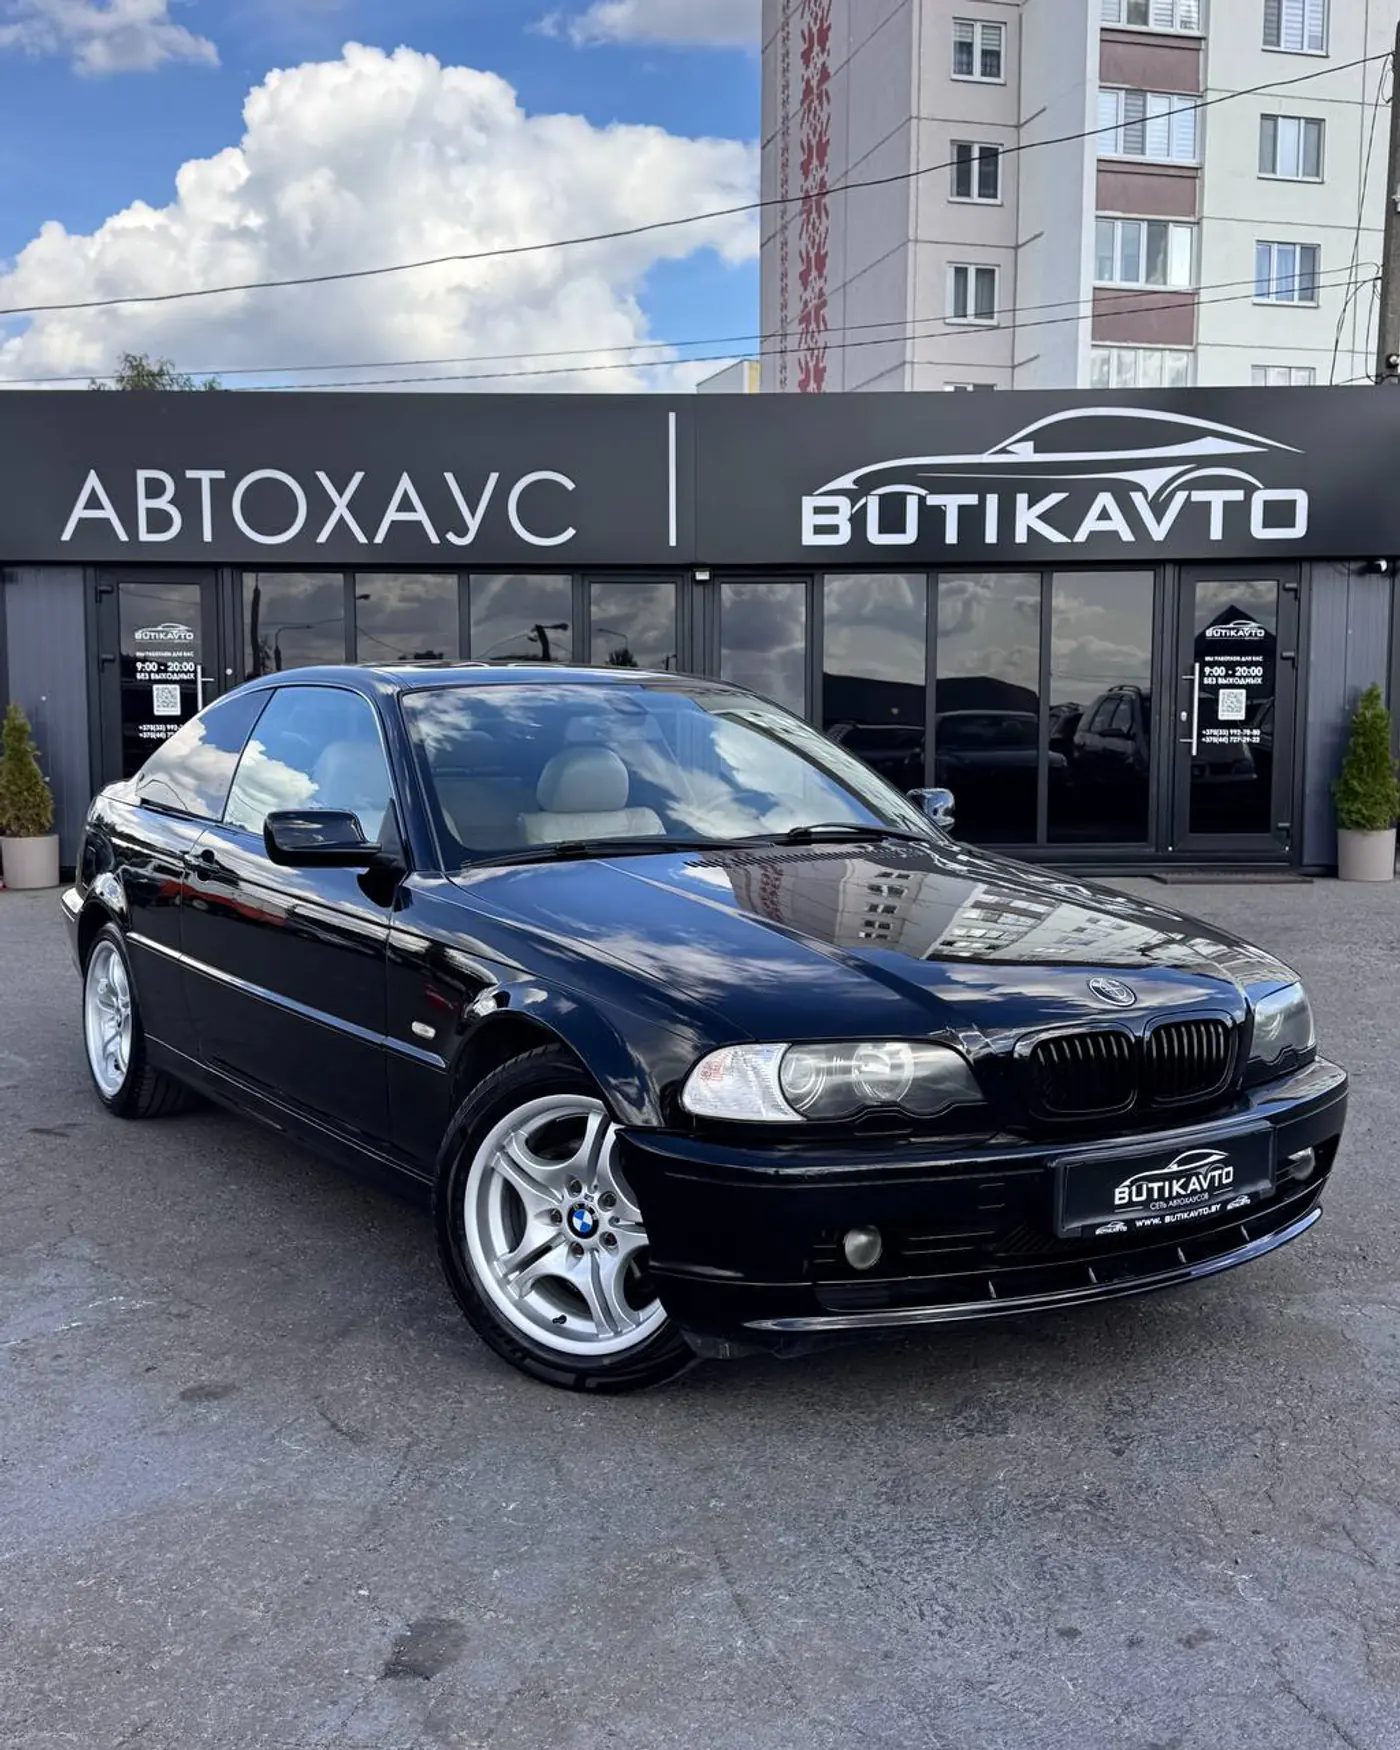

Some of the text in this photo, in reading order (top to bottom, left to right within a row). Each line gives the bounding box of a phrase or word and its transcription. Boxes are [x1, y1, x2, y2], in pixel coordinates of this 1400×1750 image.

[60, 469, 577, 547] АВТОХАУС
[801, 488, 1309, 546] BUTIKAVTO
[134, 631, 194, 640] BUTIKAVTO
[1205, 629, 1265, 637] BUTIKAVTO
[136, 662, 158, 672] 9:00
[167, 662, 194, 672] 20:00
[1204, 666, 1226, 676] 9:00
[1235, 666, 1263, 676] 20:00
[151, 673, 195, 681] ВЫХОДНЫХ
[1217, 677, 1263, 685] ВЫХОДНЫХ
[1114, 1166, 1234, 1205] BUTIKAVTO
[1165, 1204, 1221, 1224] BUTIKAVTO.BY
